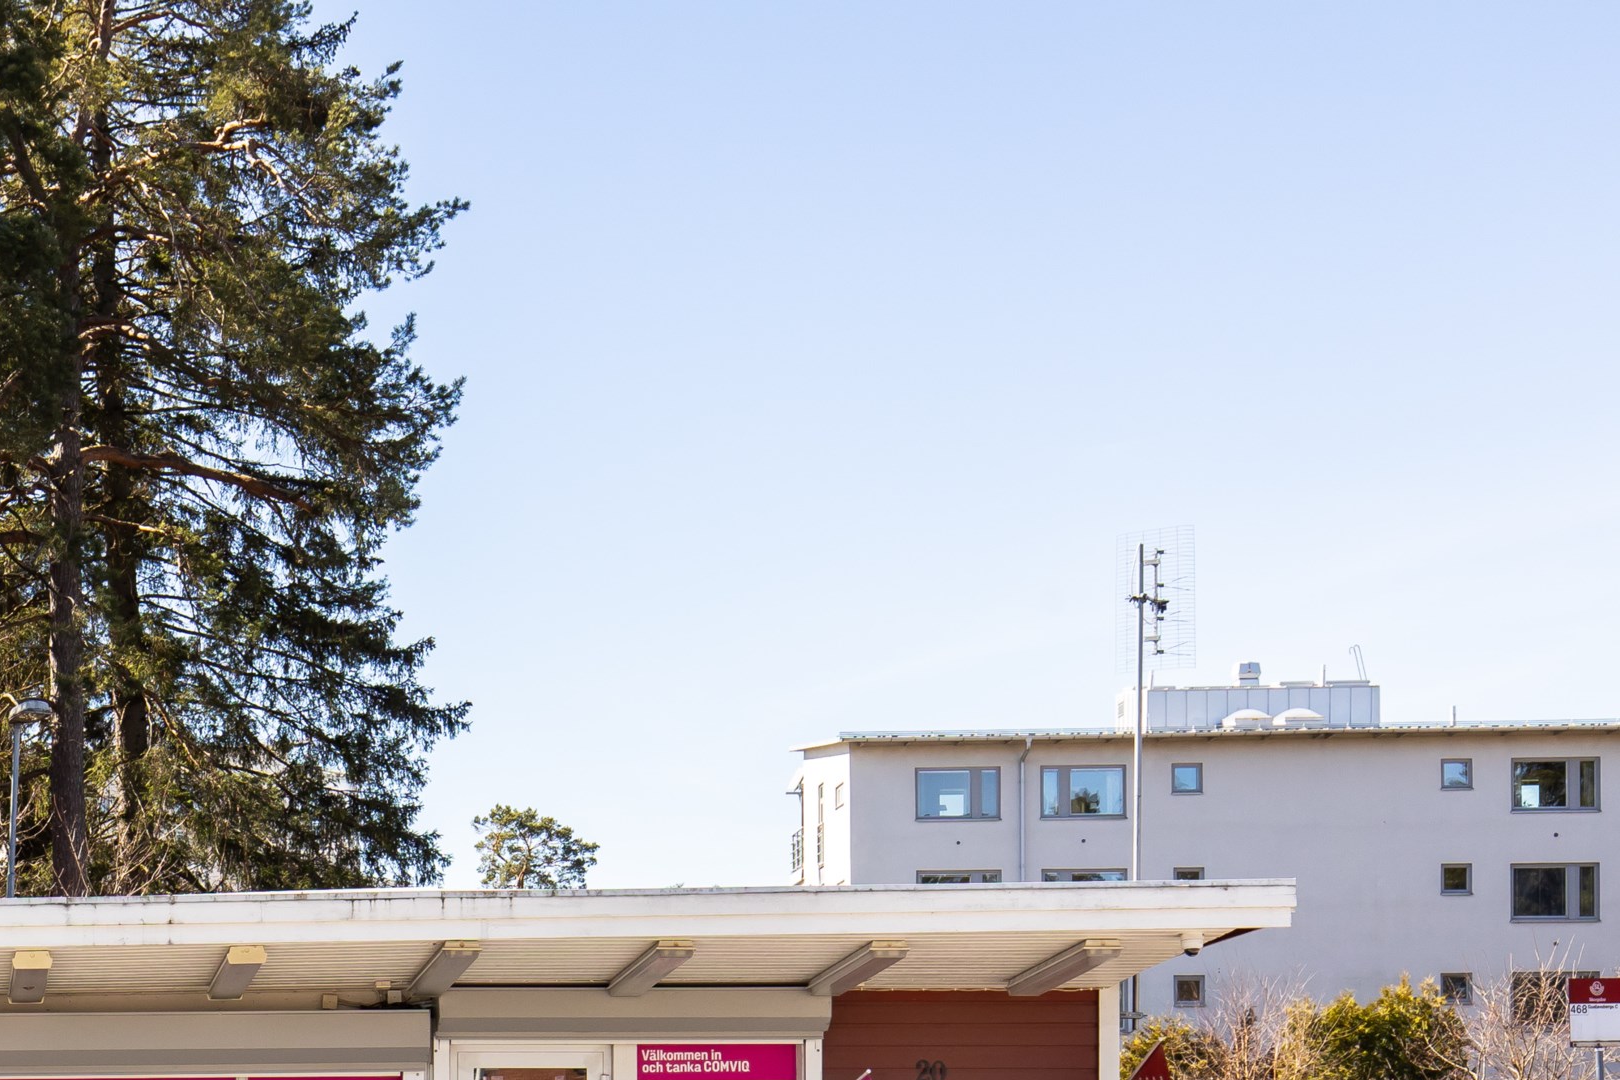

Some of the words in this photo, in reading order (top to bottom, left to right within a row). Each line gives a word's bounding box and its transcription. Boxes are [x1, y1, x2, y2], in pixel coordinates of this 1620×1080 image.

[1571, 1004, 1588, 1014] 468
[641, 1049, 708, 1061] Välkommen
[711, 1049, 721, 1060] in
[642, 1062, 663, 1073] och
[666, 1062, 701, 1072] tanka
[704, 1060, 750, 1072] COMVIQ
